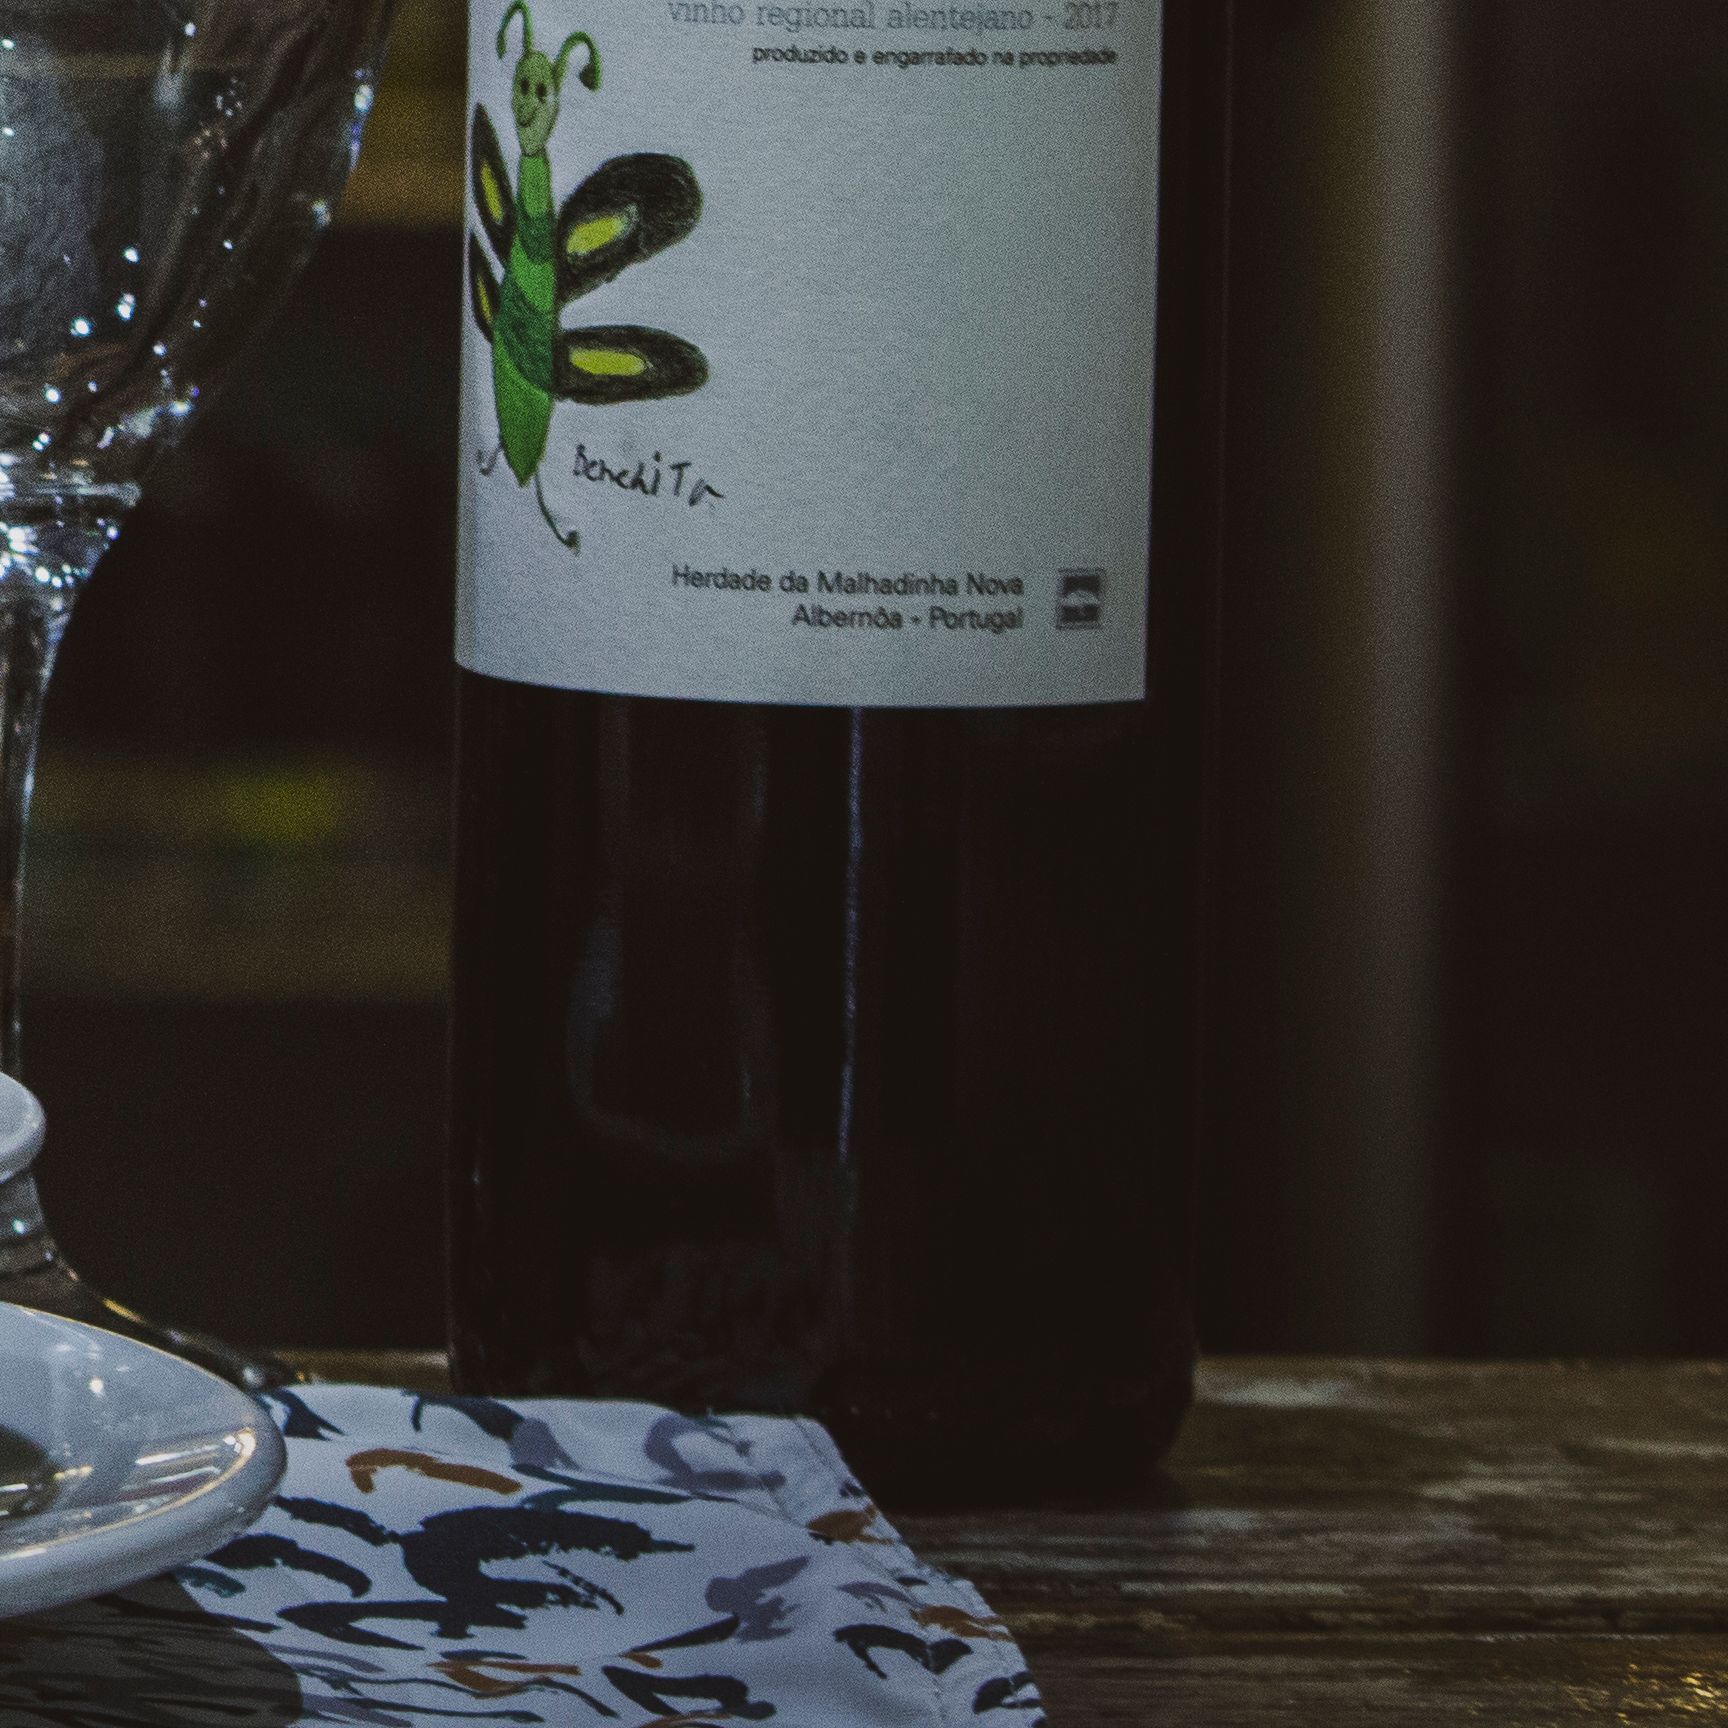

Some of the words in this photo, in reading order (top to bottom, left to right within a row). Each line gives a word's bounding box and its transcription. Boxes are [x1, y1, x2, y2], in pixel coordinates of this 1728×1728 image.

[756, 0, 877, 33] regional
[886, 0, 1034, 37] alentejano
[1064, 0, 1119, 31] 2017
[752, 44, 849, 65] produzido
[853, 49, 867, 65] e
[871, 46, 989, 69] engarrafado
[992, 50, 1015, 66] na
[671, 563, 773, 593] Herdade
[778, 569, 810, 594] da
[817, 570, 960, 596] Malhadinha
[966, 572, 1025, 596] Nova
[929, 604, 1025, 635] Portugal
